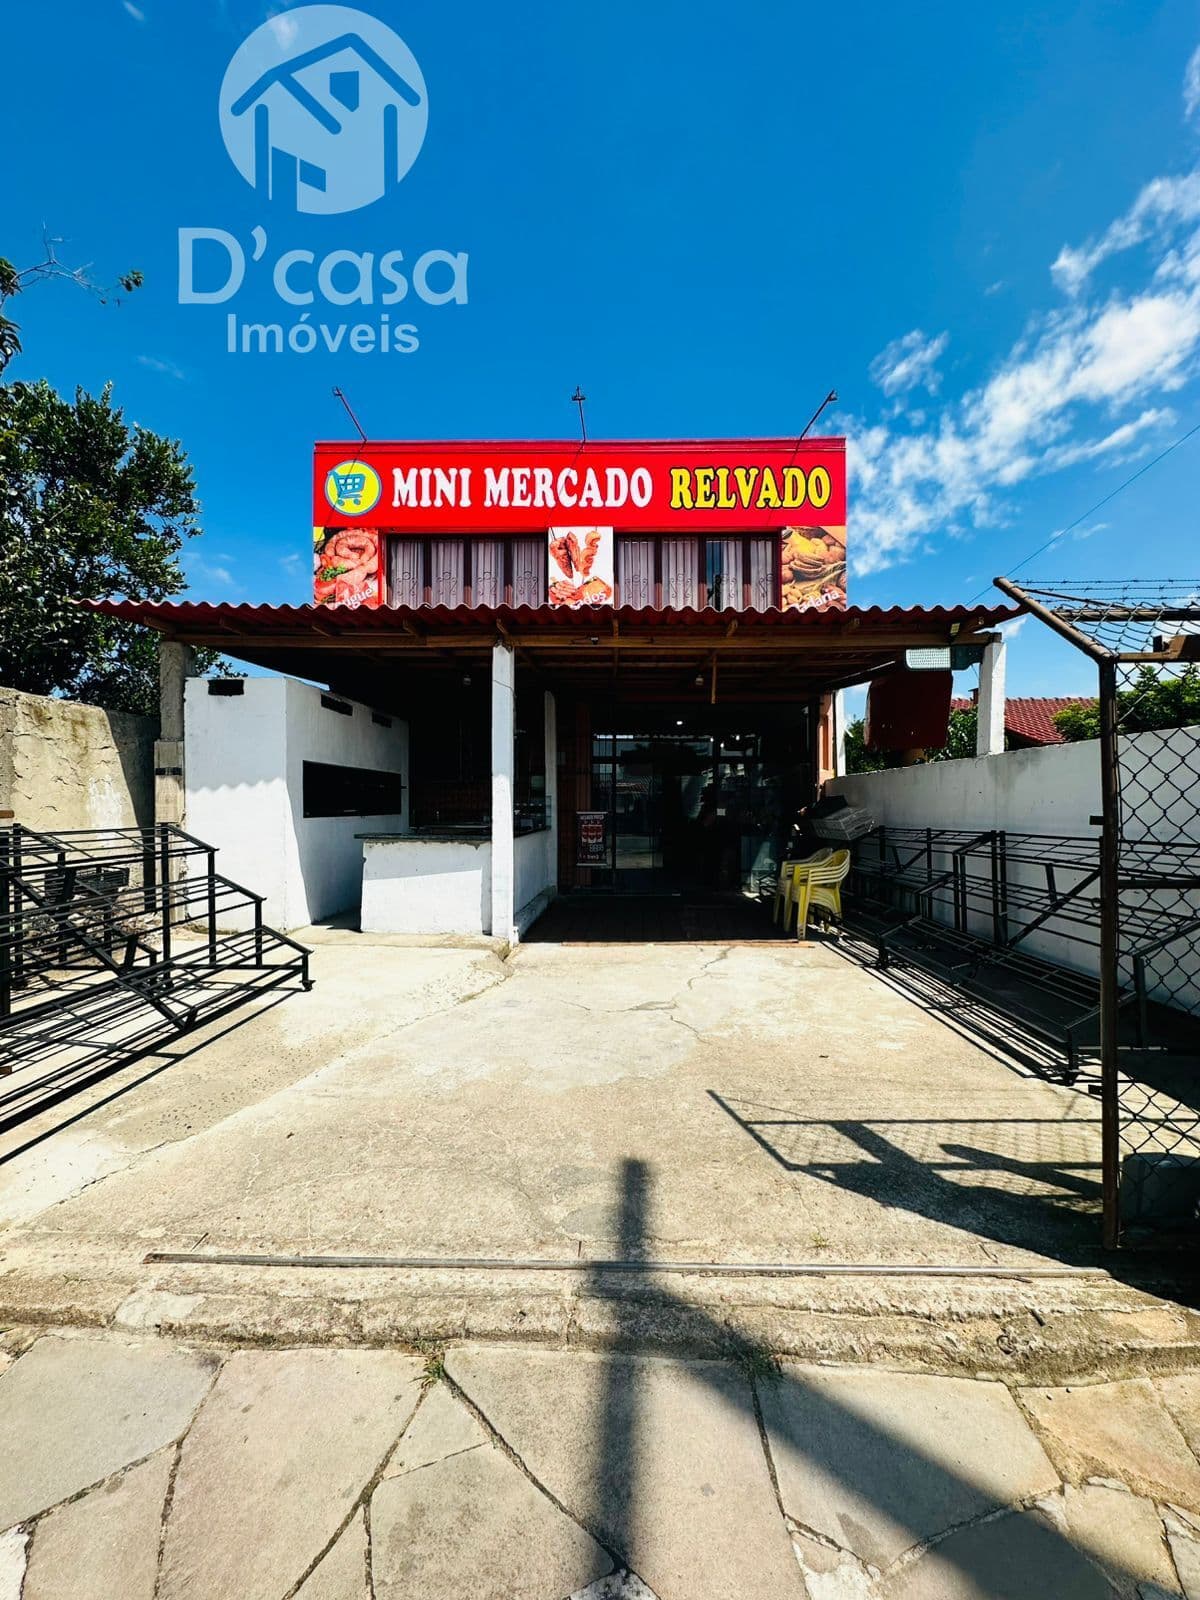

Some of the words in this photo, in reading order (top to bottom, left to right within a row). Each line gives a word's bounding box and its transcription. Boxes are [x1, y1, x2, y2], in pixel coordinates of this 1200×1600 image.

[391, 466, 472, 508] MINI
[483, 466, 654, 508] MERCADO
[669, 465, 833, 510] RELVADO
[788, 588, 841, 613] adaria
